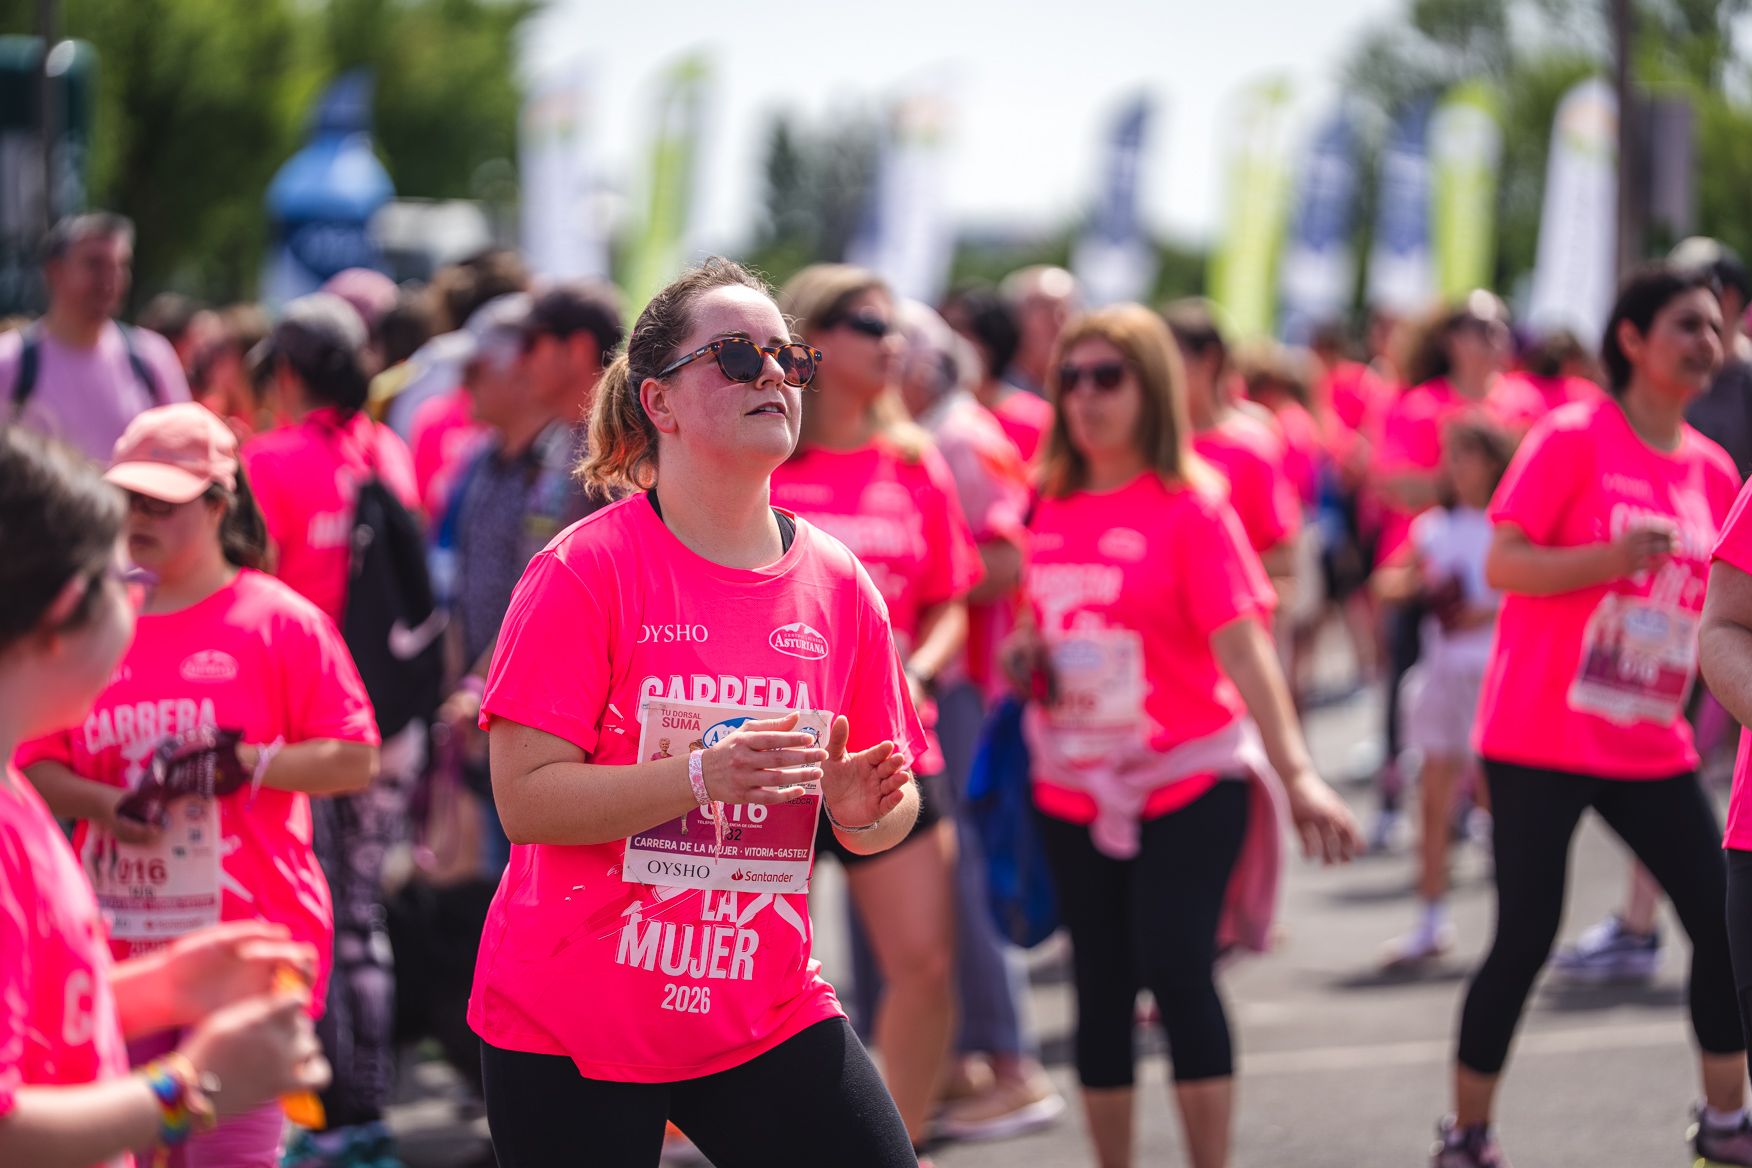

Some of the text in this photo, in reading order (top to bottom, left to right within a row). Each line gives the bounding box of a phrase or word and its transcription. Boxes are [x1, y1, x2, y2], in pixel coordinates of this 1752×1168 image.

[637, 624, 709, 643] OYSHO
[774, 633, 825, 655] ASTURIANA
[662, 717, 701, 731] SUMA
[673, 710, 702, 719] DORSAL
[83, 697, 217, 755] CARRERA
[726, 828, 742, 841] 32
[634, 836, 808, 859] CARRERA DE LA MUJER VITORIA-GASTEIZ
[647, 859, 710, 879] OYSHO
[744, 870, 793, 883] Santander
[700, 889, 738, 923] LA
[615, 913, 760, 981] MUJER
[661, 983, 711, 1015] 2026
